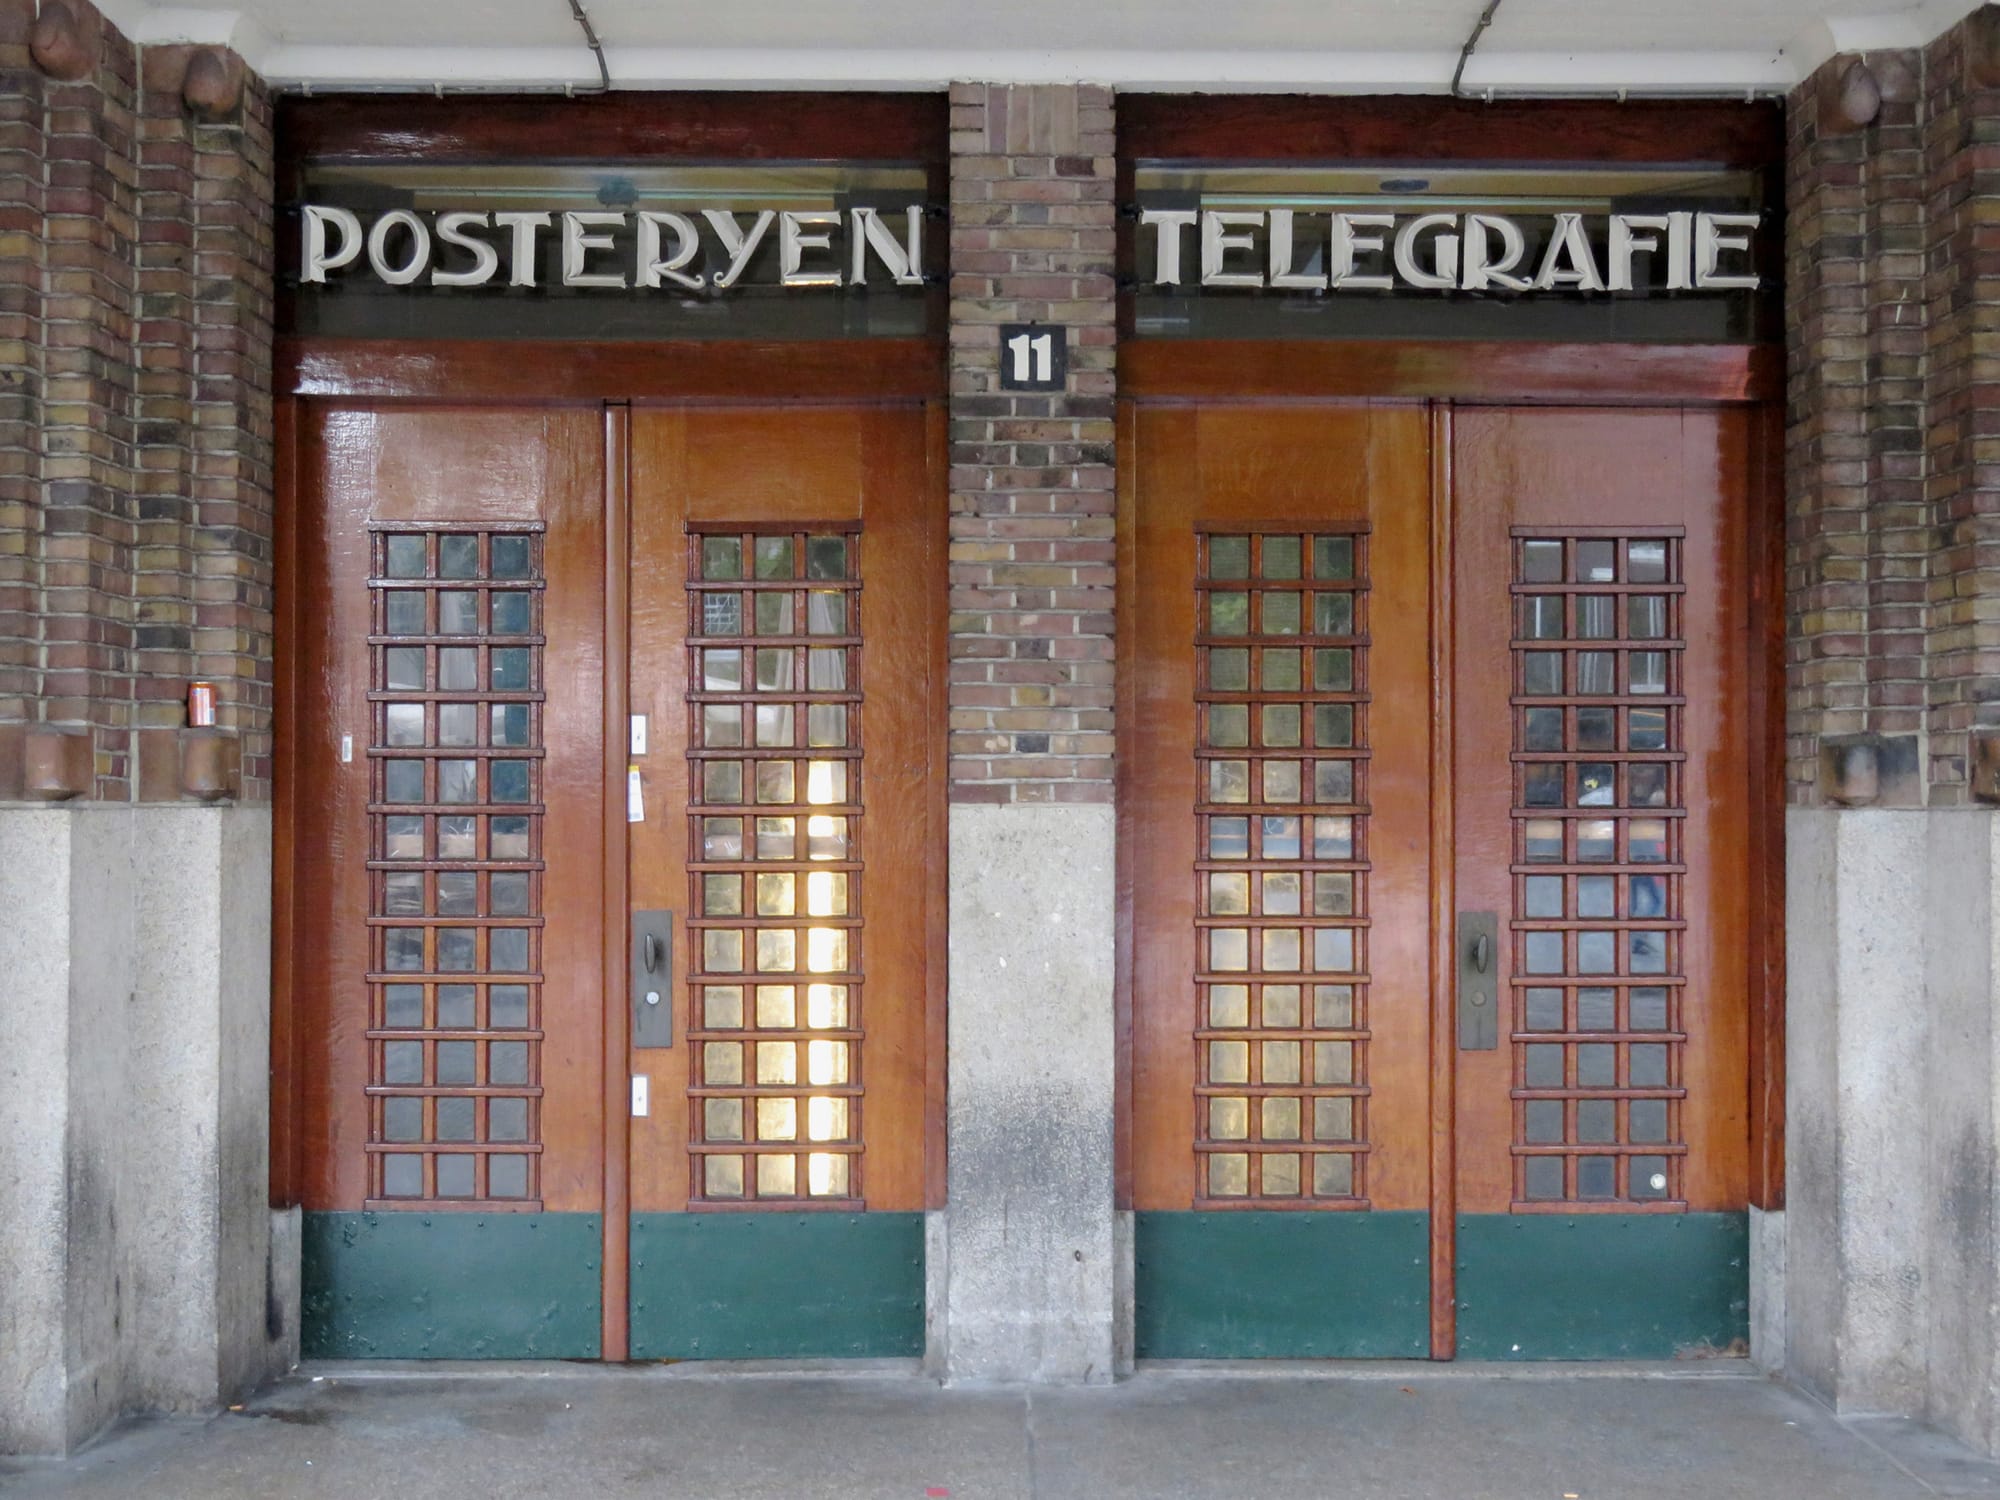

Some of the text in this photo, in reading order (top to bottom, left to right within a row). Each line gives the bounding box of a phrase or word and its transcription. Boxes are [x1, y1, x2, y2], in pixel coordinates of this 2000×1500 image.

[301, 204, 924, 288] POSTERYEN
[1142, 208, 1760, 291] TELEGRAFIE
[1008, 333, 1053, 383] 11
